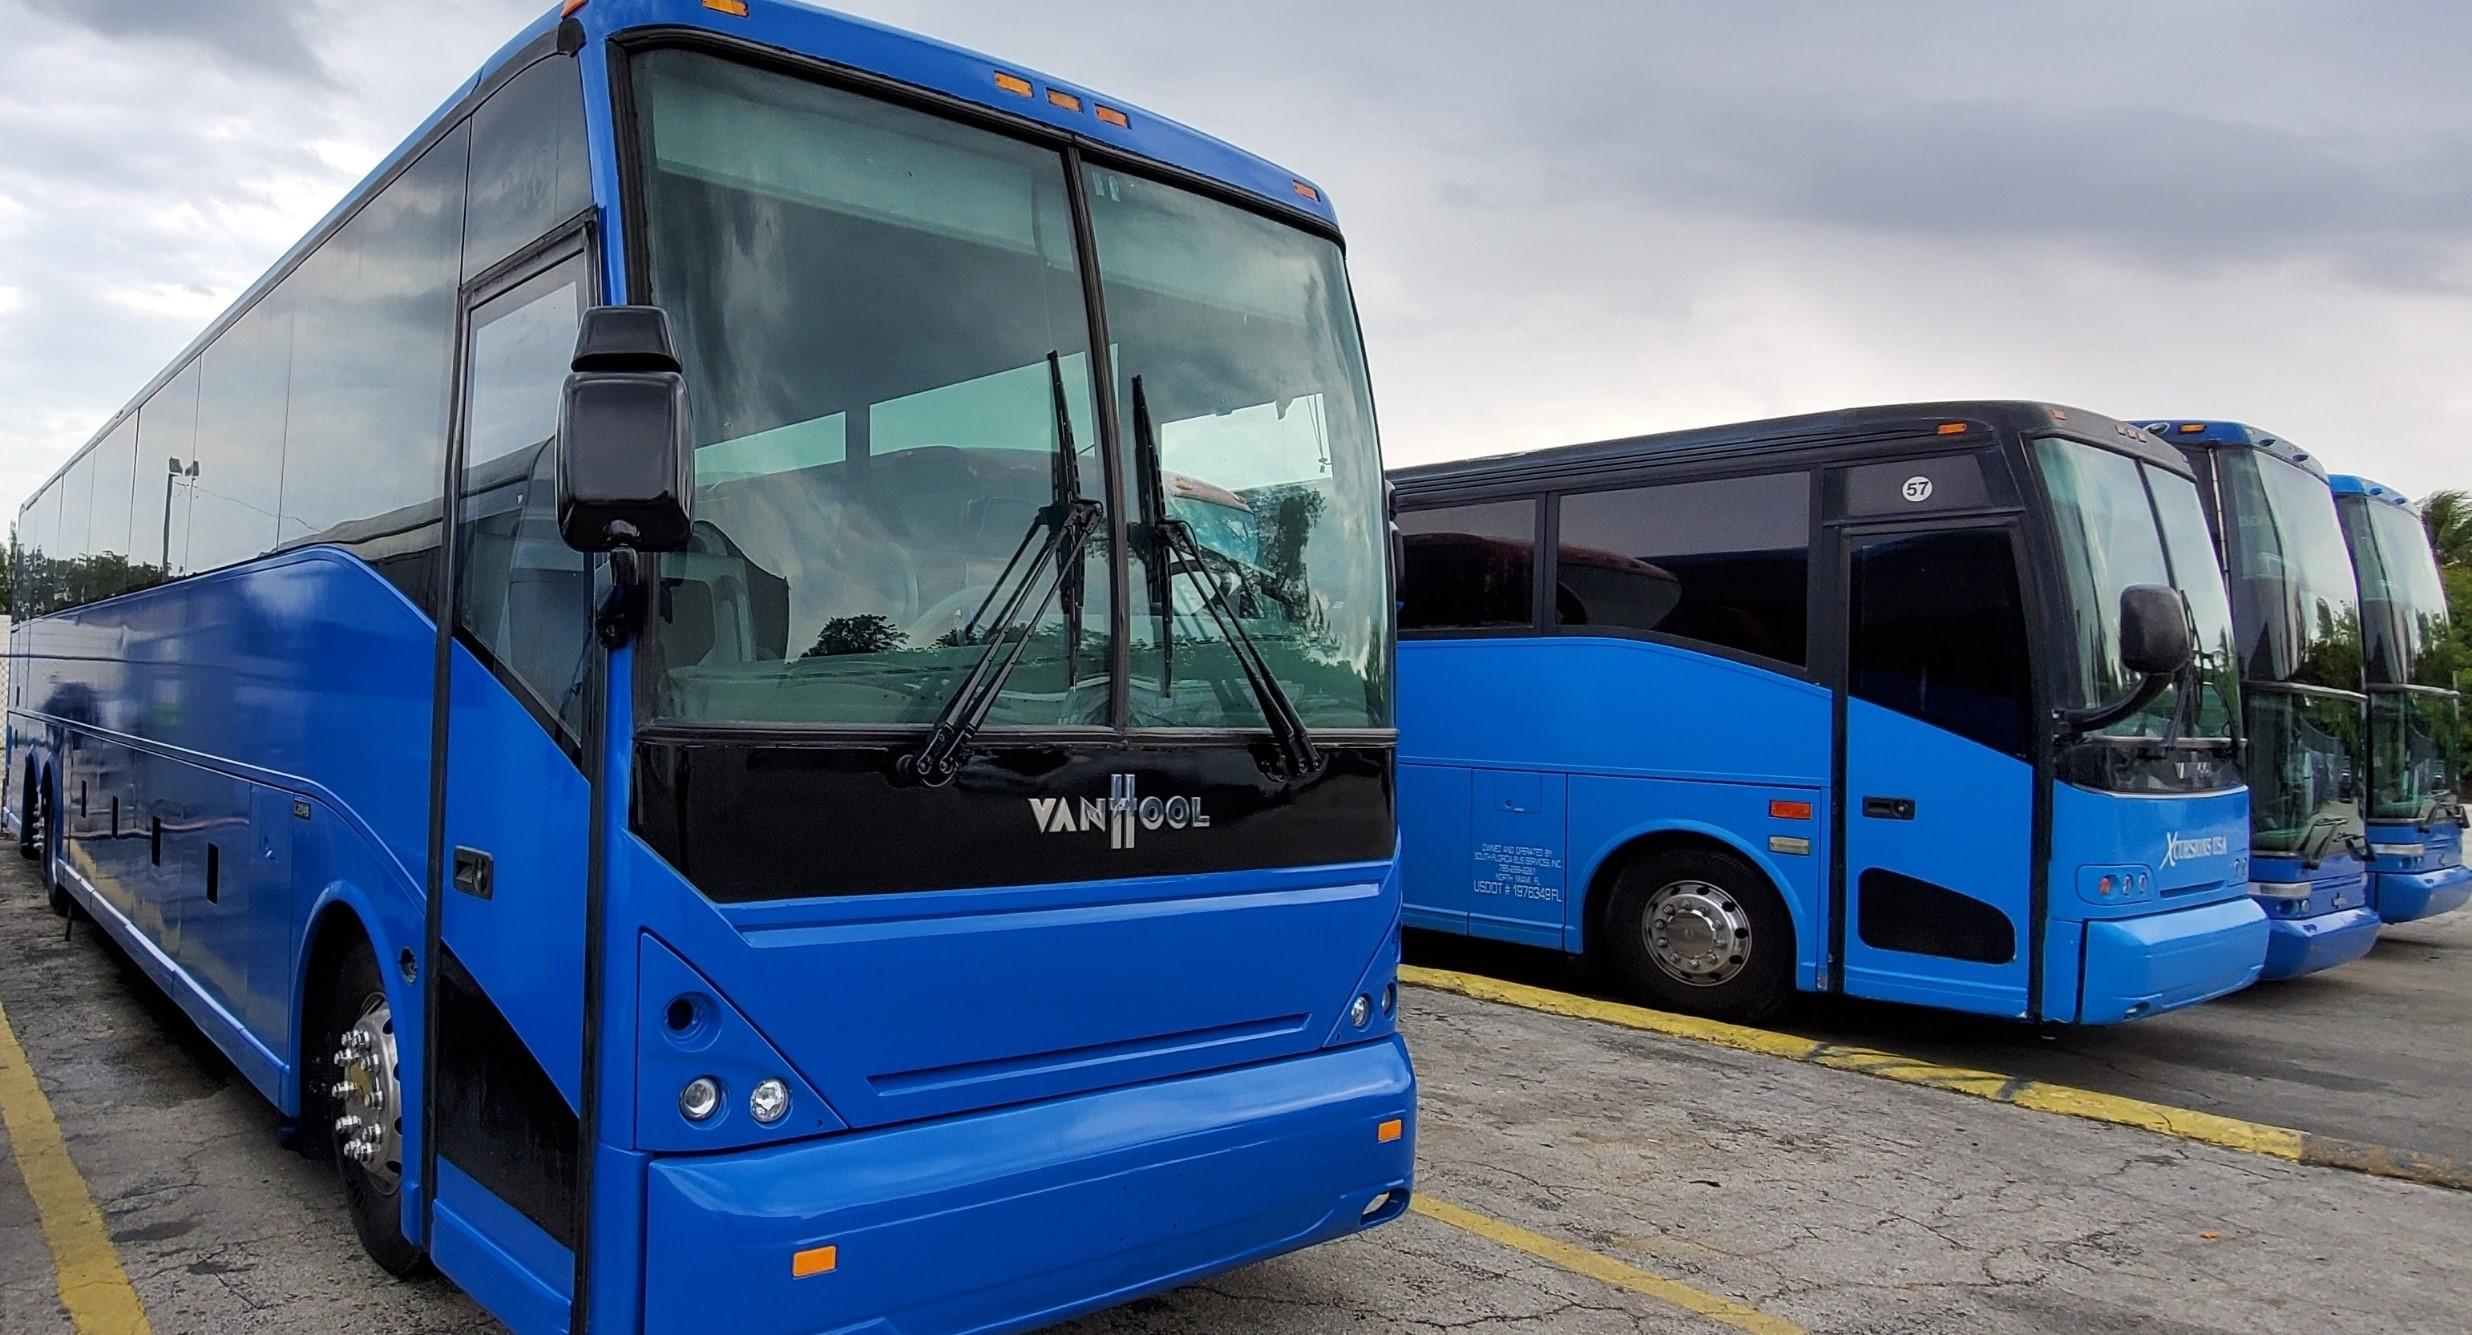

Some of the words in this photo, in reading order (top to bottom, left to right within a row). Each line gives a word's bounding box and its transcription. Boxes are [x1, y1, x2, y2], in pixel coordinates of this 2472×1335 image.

[1906, 481, 1929, 497] 57
[2212, 836, 2227, 855] USA
[1473, 880, 1503, 895] USDOT
